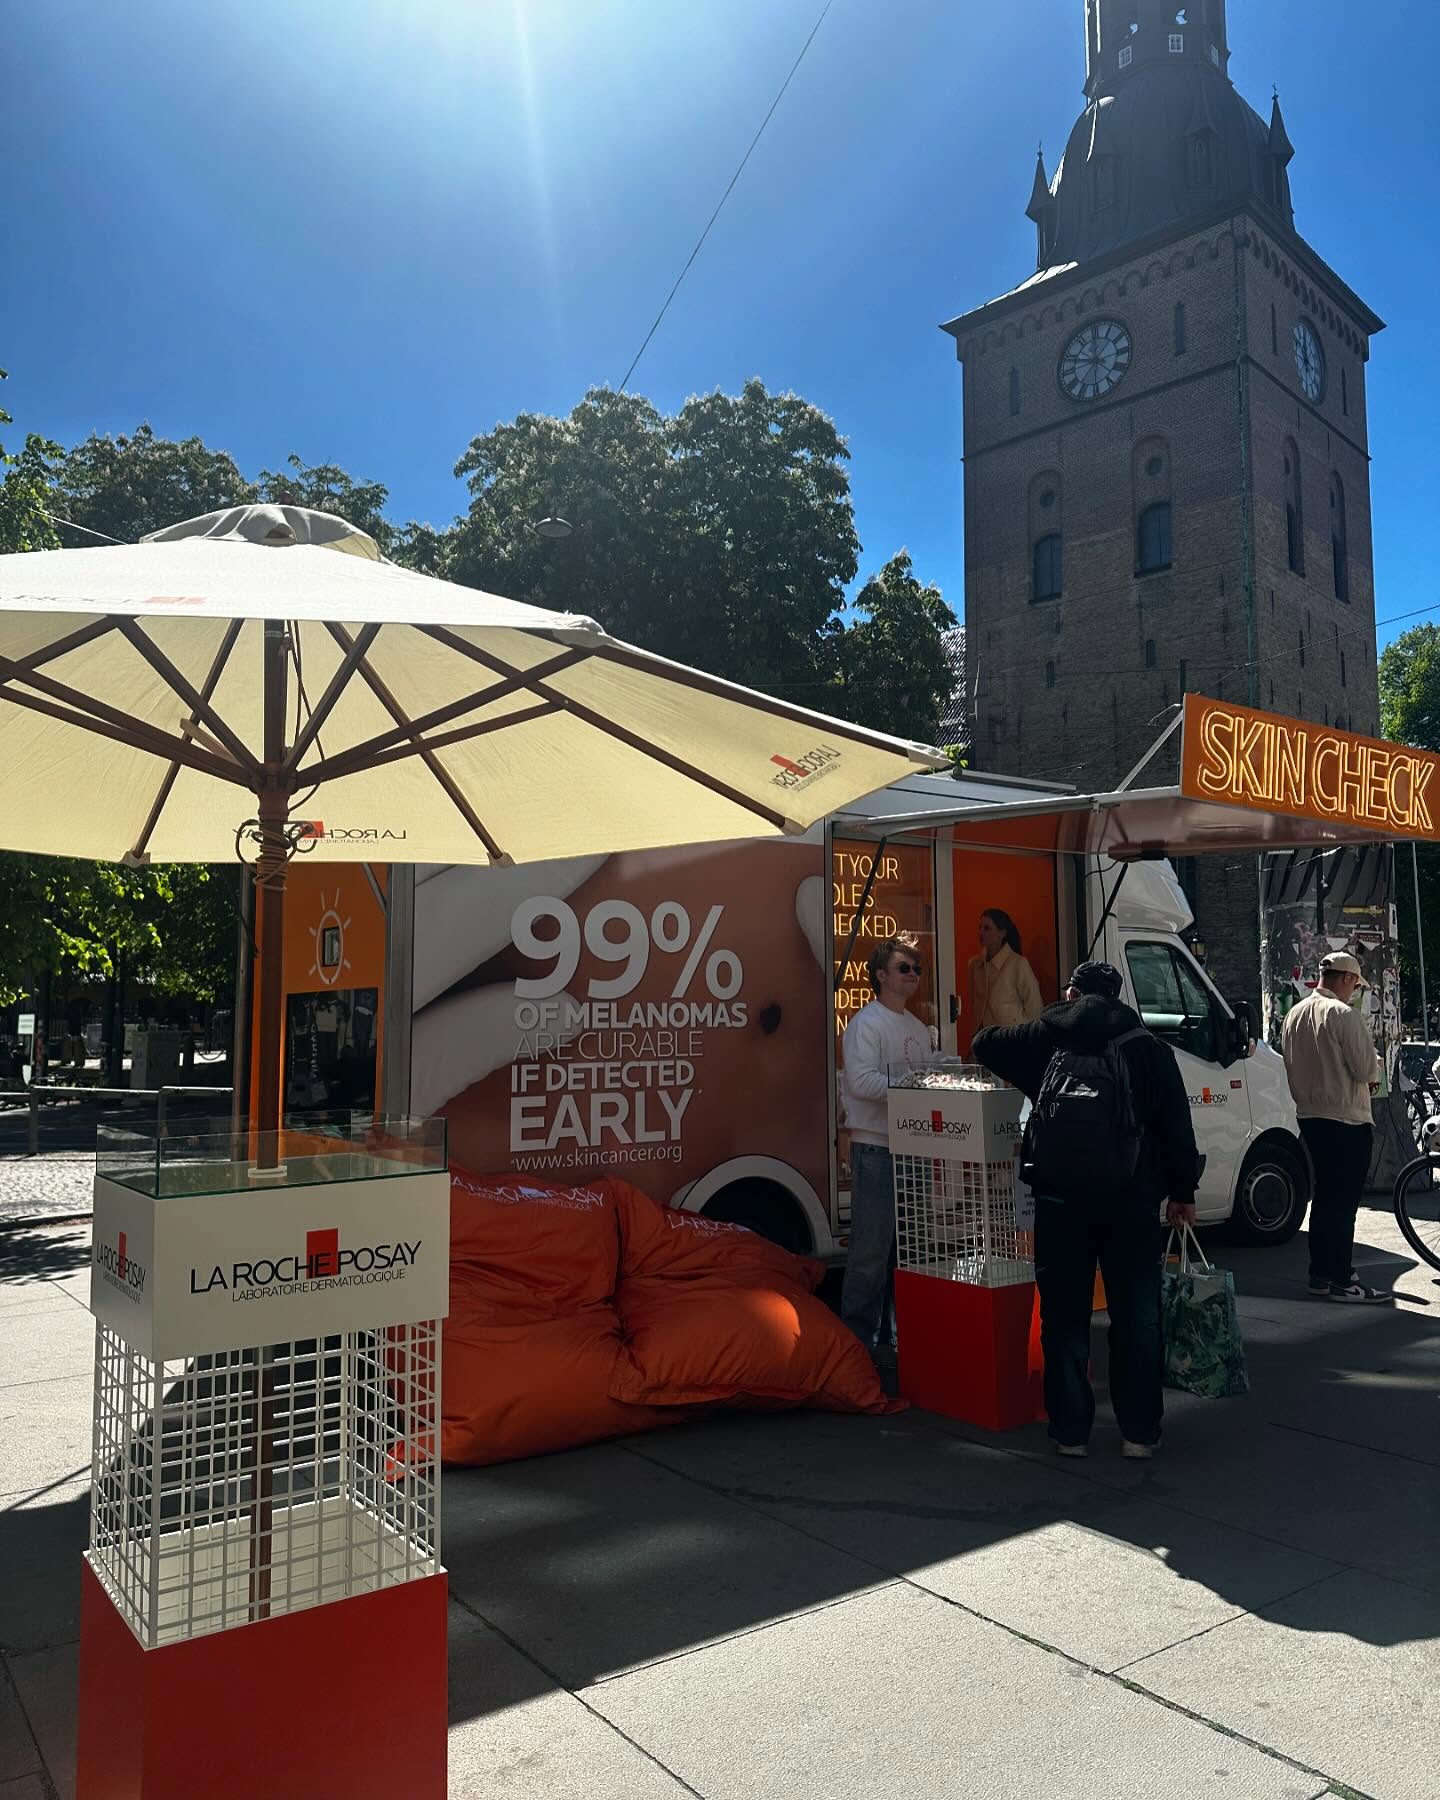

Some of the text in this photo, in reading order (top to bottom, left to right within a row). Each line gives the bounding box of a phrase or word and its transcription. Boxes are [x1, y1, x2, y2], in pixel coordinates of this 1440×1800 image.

[1199, 709, 1435, 831] SKIN CHECK
[849, 855, 899, 880] YOUR
[510, 895, 744, 1000] 99%
[514, 1002, 748, 1030] OF MELANOMAS
[513, 1030, 704, 1061] ARE CURABLE
[511, 1060, 695, 1093] IF DETECTED
[897, 1118, 972, 1136] LA ROCHE POSAY
[993, 1121, 1006, 1136] LA
[125, 1257, 147, 1293] POSAY
[190, 1240, 423, 1295] LA ROCHE POSAY
[232, 1267, 406, 1302] LABORATOIRE DERMATOLOGIQUE
